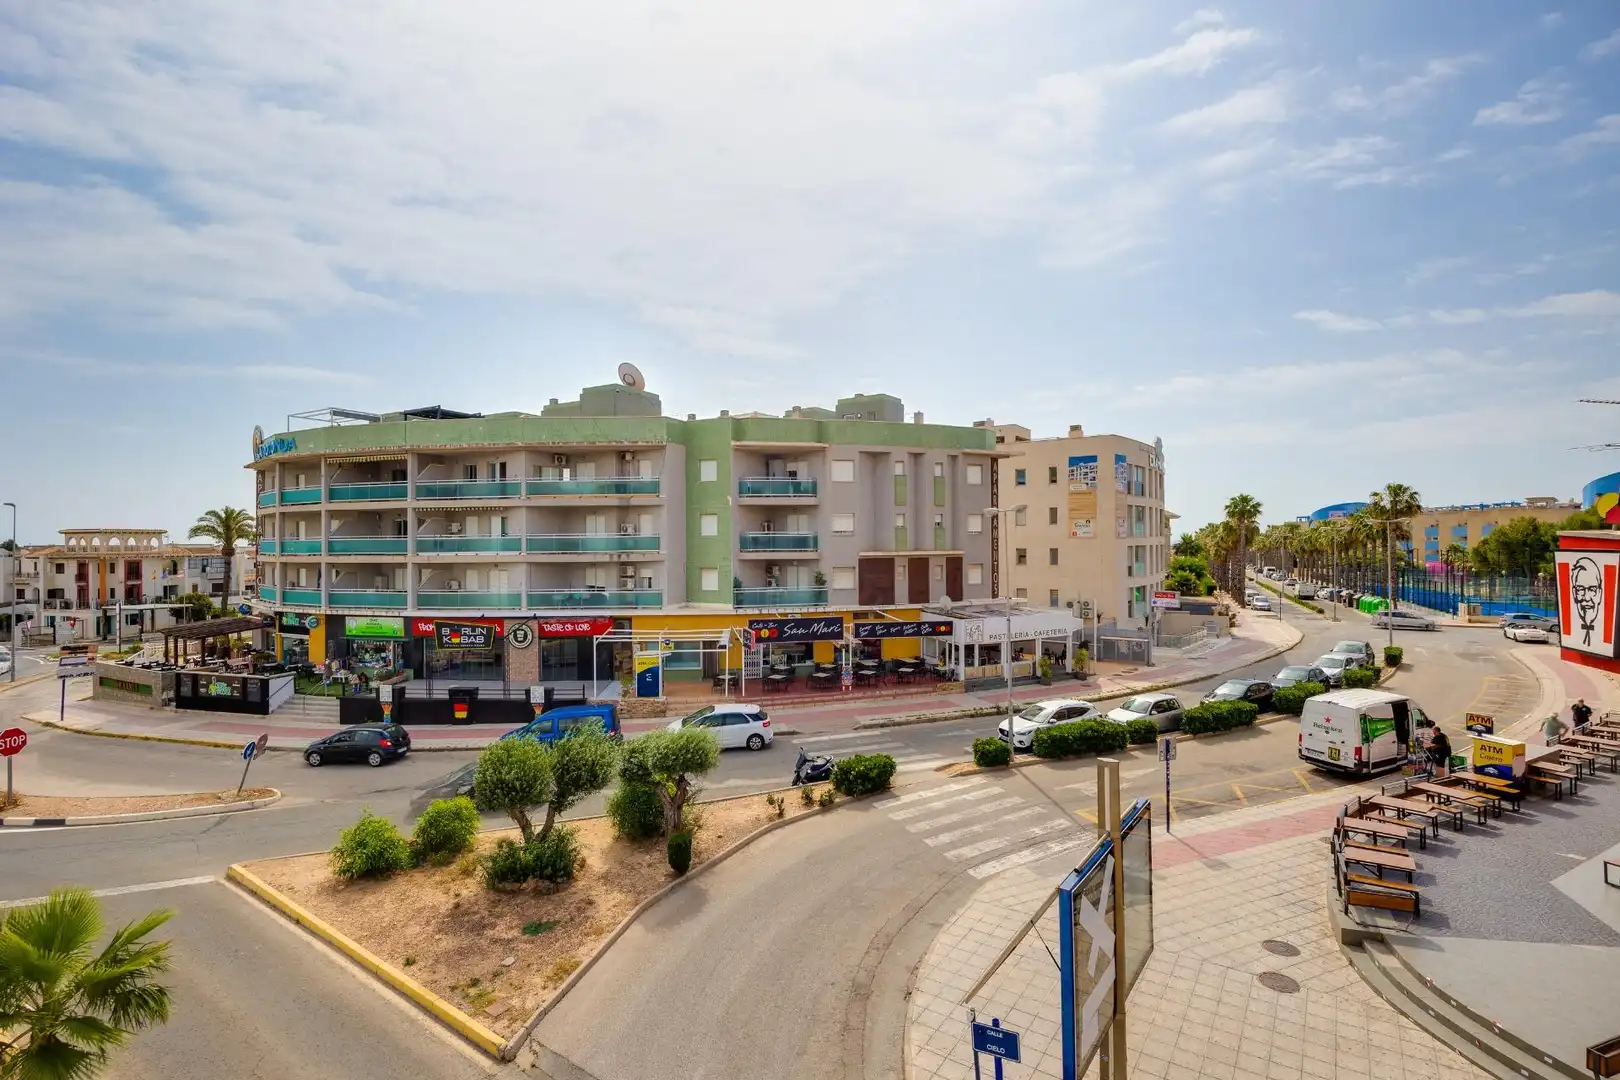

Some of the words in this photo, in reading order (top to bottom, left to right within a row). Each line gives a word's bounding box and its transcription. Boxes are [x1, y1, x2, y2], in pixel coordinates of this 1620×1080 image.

[783, 623, 809, 637] San
[809, 621, 841, 635] Mari
[1468, 715, 1491, 725] ATM
[1312, 722, 1343, 734] Heineken
[0, 735, 26, 750] STOP
[1480, 744, 1503, 754] ATM
[1479, 753, 1504, 763] Cajero
[987, 1030, 1003, 1038] CALLE
[987, 1044, 1005, 1053] CIELO
